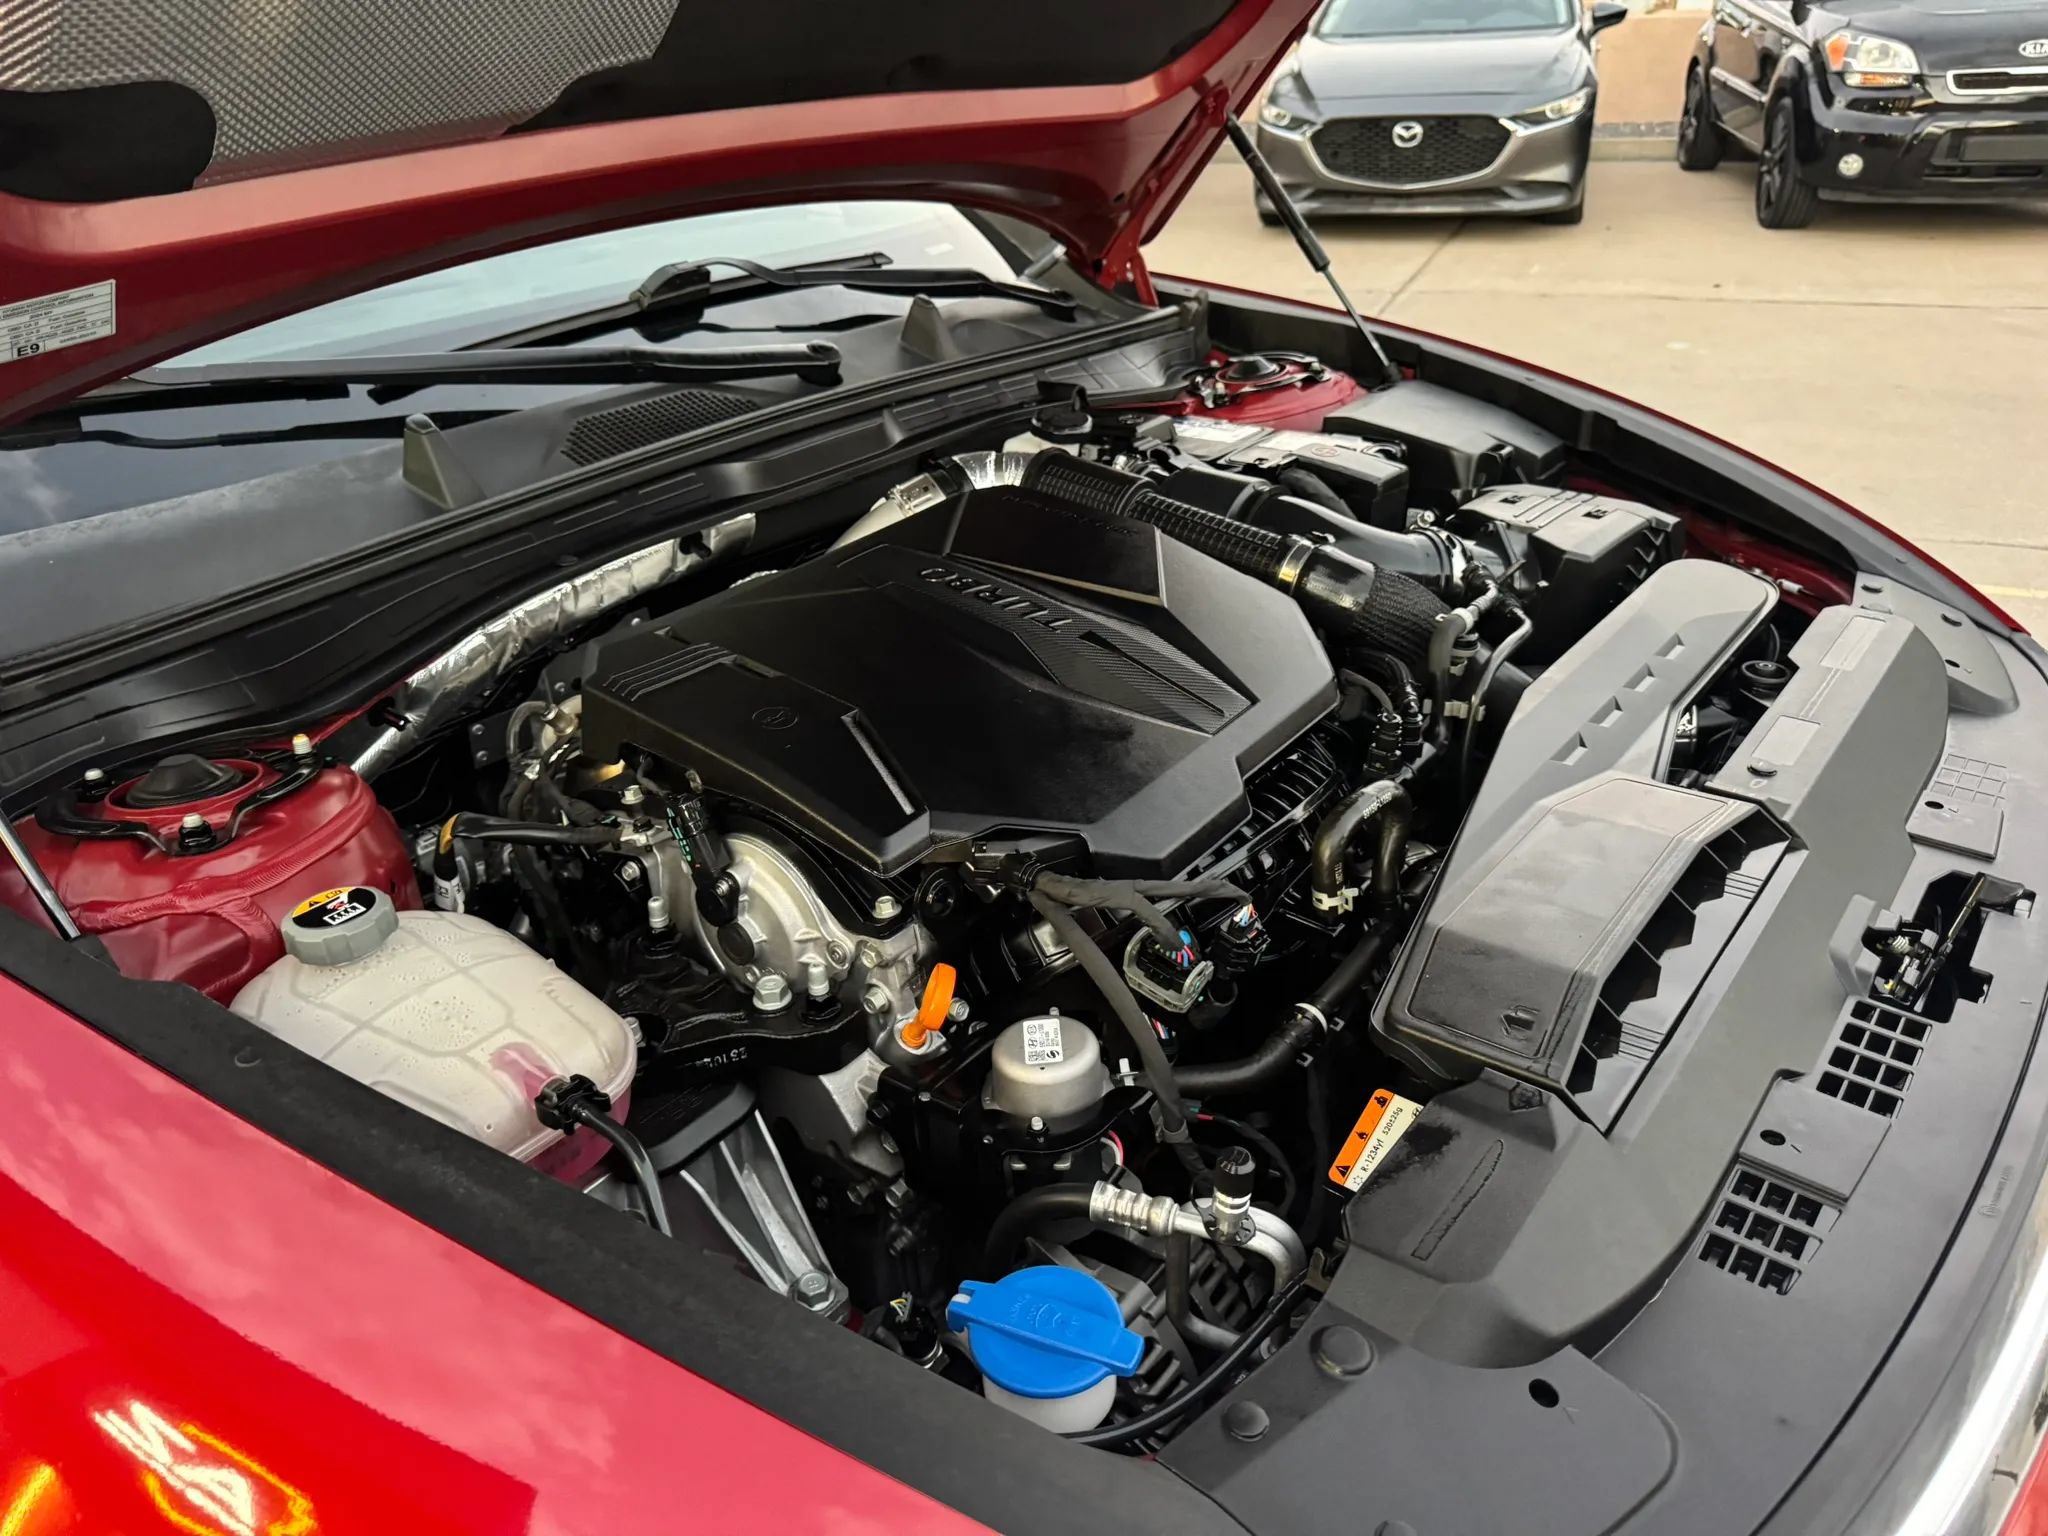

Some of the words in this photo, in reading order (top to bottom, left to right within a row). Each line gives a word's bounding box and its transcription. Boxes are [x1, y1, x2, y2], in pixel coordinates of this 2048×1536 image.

[17, 343, 40, 358] E9
[920, 567, 1073, 633] TURBO
[1360, 1138, 1384, 1173] R-1234yf
[1382, 1106, 1403, 1136] 520±25g
